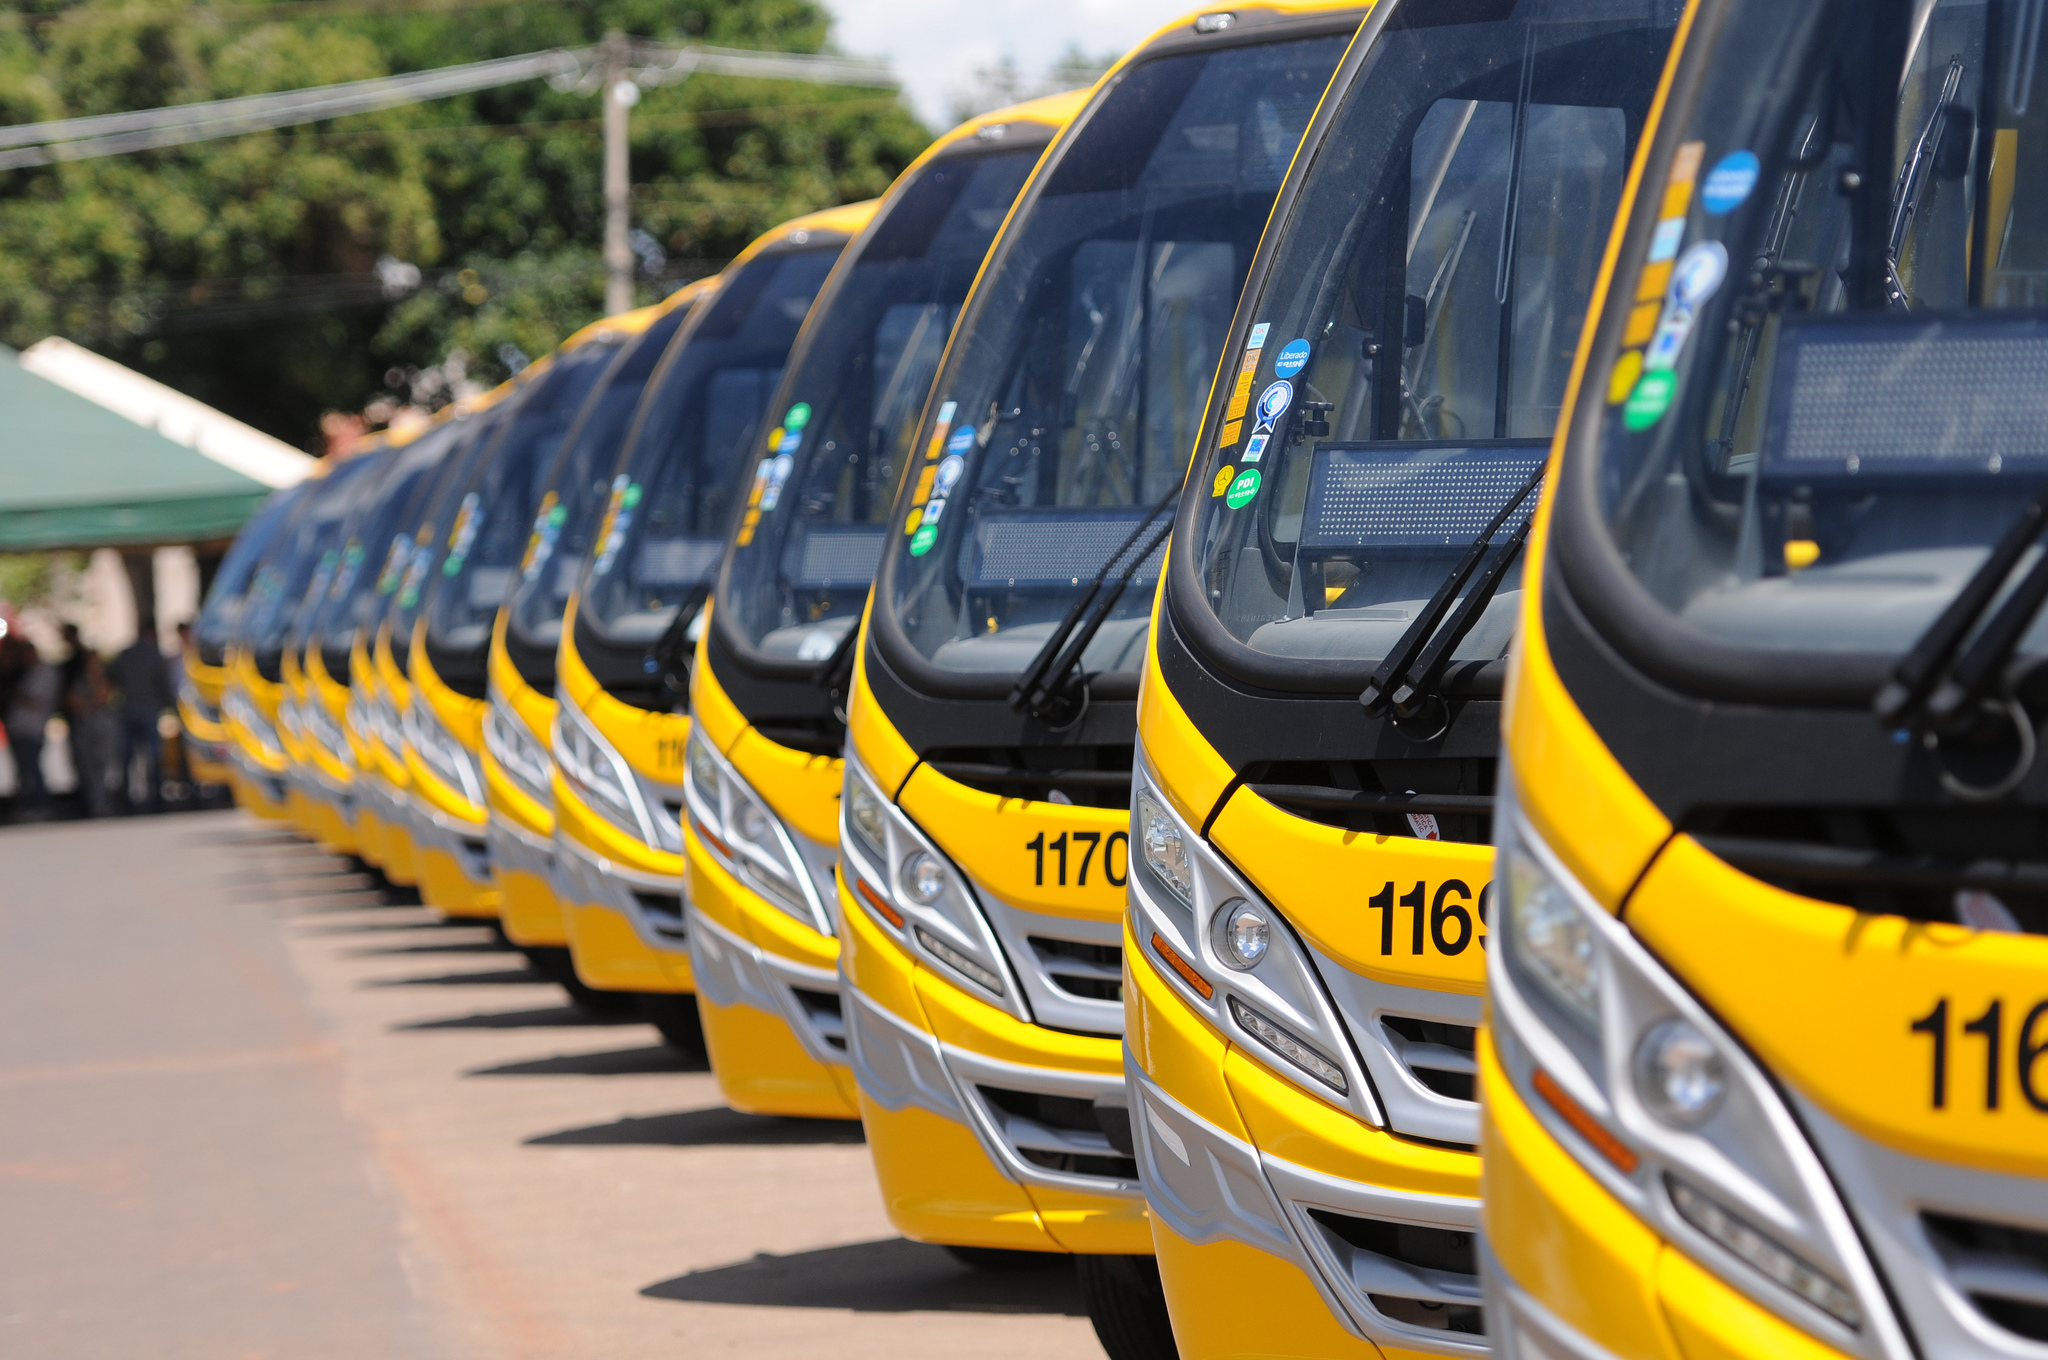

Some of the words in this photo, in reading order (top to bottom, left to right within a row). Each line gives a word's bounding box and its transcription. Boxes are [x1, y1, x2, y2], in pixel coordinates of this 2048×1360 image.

[1280, 351, 1308, 360] Liberado
[1236, 476, 1255, 490] PDI
[1026, 831, 1129, 887] 1170
